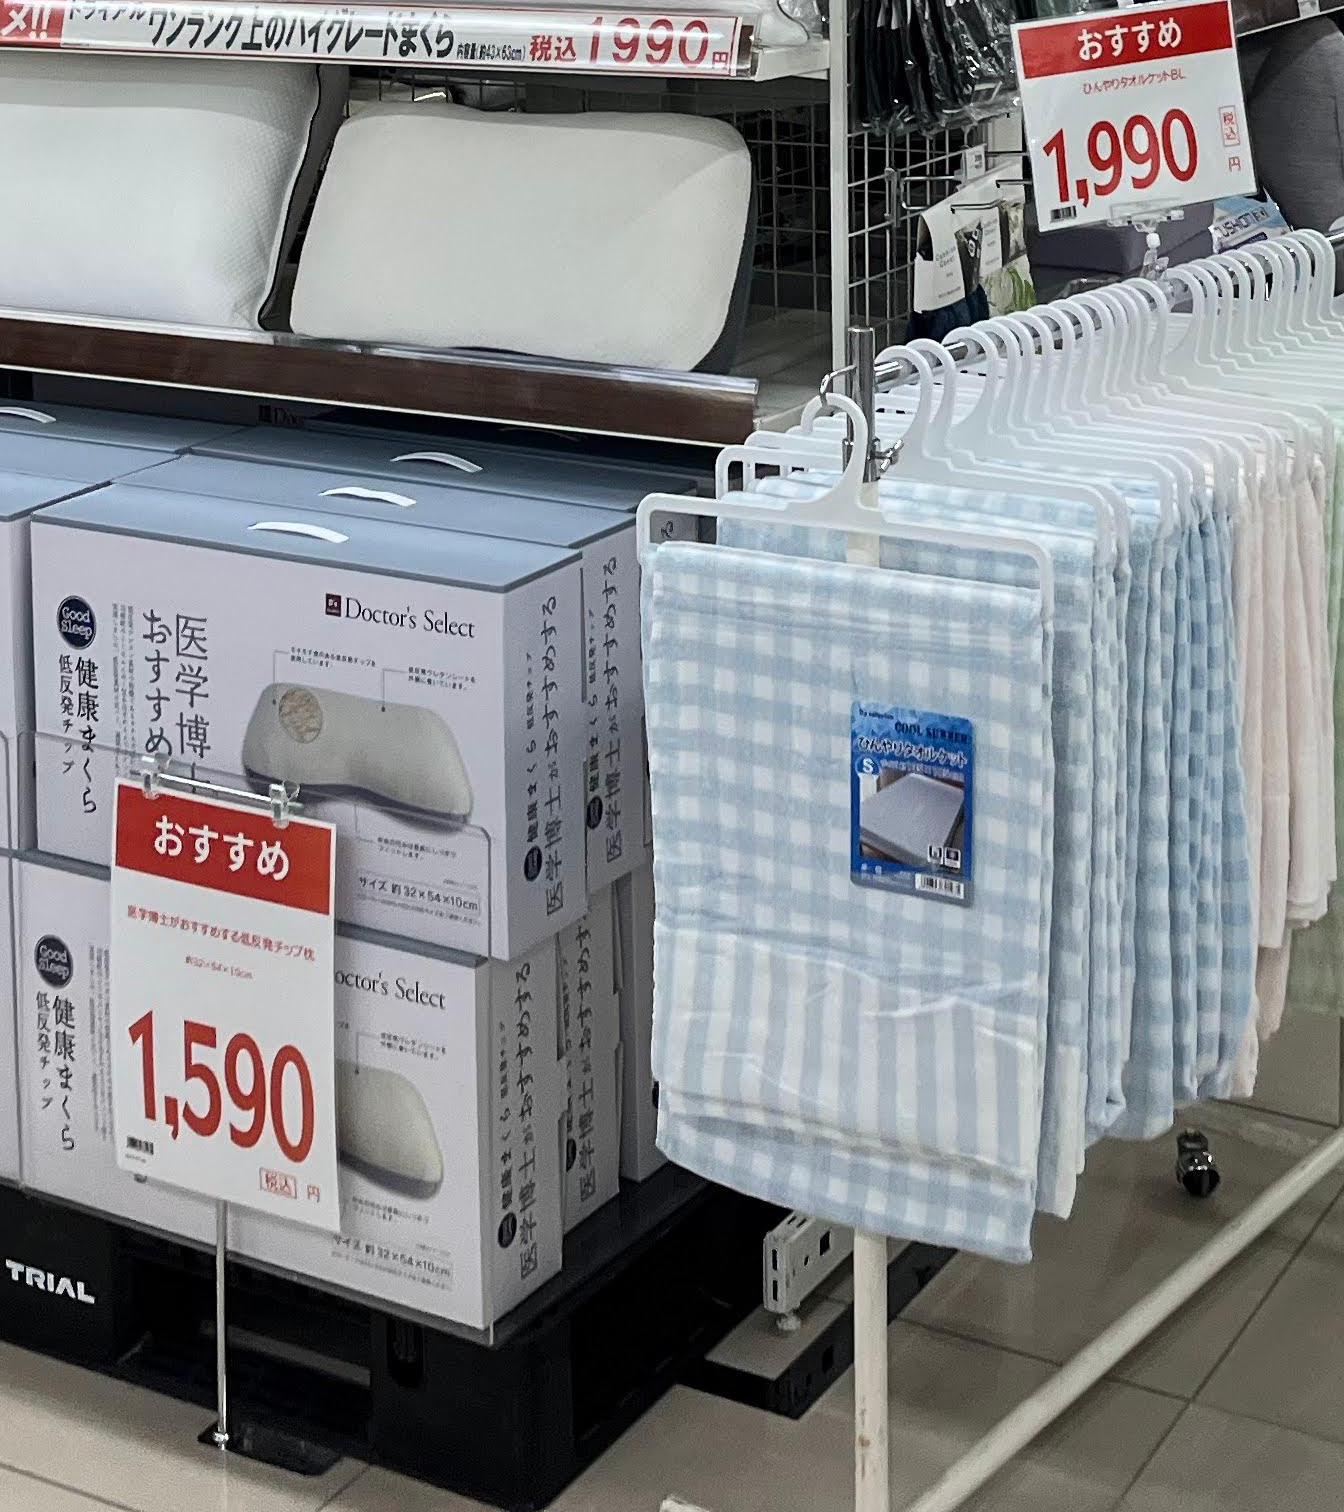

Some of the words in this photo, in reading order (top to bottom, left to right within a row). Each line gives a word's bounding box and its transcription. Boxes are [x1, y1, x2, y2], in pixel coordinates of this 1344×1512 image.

[148, 7, 456, 58] ワンランク上のハイグレードまくら
[529, 35, 578, 62] 税込
[587, 16, 711, 70] 1990
[1076, 16, 1183, 62] おすすめ
[712, 50, 729, 69] 円
[1082, 68, 1187, 96] ひんやりタオルケットBL
[1223, 112, 1238, 140] 税込
[1042, 107, 1199, 209] 1,990
[1228, 155, 1242, 173] 円
[59, 619, 93, 641] Sleep
[61, 606, 91, 624] Good
[344, 596, 417, 630] Doctor's
[423, 608, 475, 639] Select
[58, 653, 74, 775] 低反発チップ
[602, 556, 623, 864] 医学博士がおすすめする
[894, 720, 923, 738] COOL
[74, 655, 99, 814] 健康まくら
[541, 595, 564, 917] 医学博士がおすすめする
[589, 693, 599, 793] 健康まくら
[857, 735, 969, 769] ひんやりタオルケット
[862, 758, 875, 773] S
[526, 738, 538, 843] 健康まくら
[153, 814, 291, 882] おすすめ
[359, 875, 389, 892] サイズ
[391, 883, 479, 910] 約32×54×10cm
[39, 944, 68, 963] Good
[126, 904, 316, 964] 医学博士がおすすめする低反発チップ枕
[334, 968, 389, 997] octor's
[393, 976, 447, 1010] Select
[36, 990, 53, 1110] 低反発チップ
[52, 995, 76, 1151] 健康まくら
[577, 915, 597, 1204] 医学博士がおすすめす
[127, 1008, 316, 1165] 1,590
[514, 962, 538, 1281] 医学博士がおすすめする
[262, 1171, 295, 1197] 税込
[307, 1184, 322, 1205] 円
[4, 1258, 97, 1306] TRIAL
